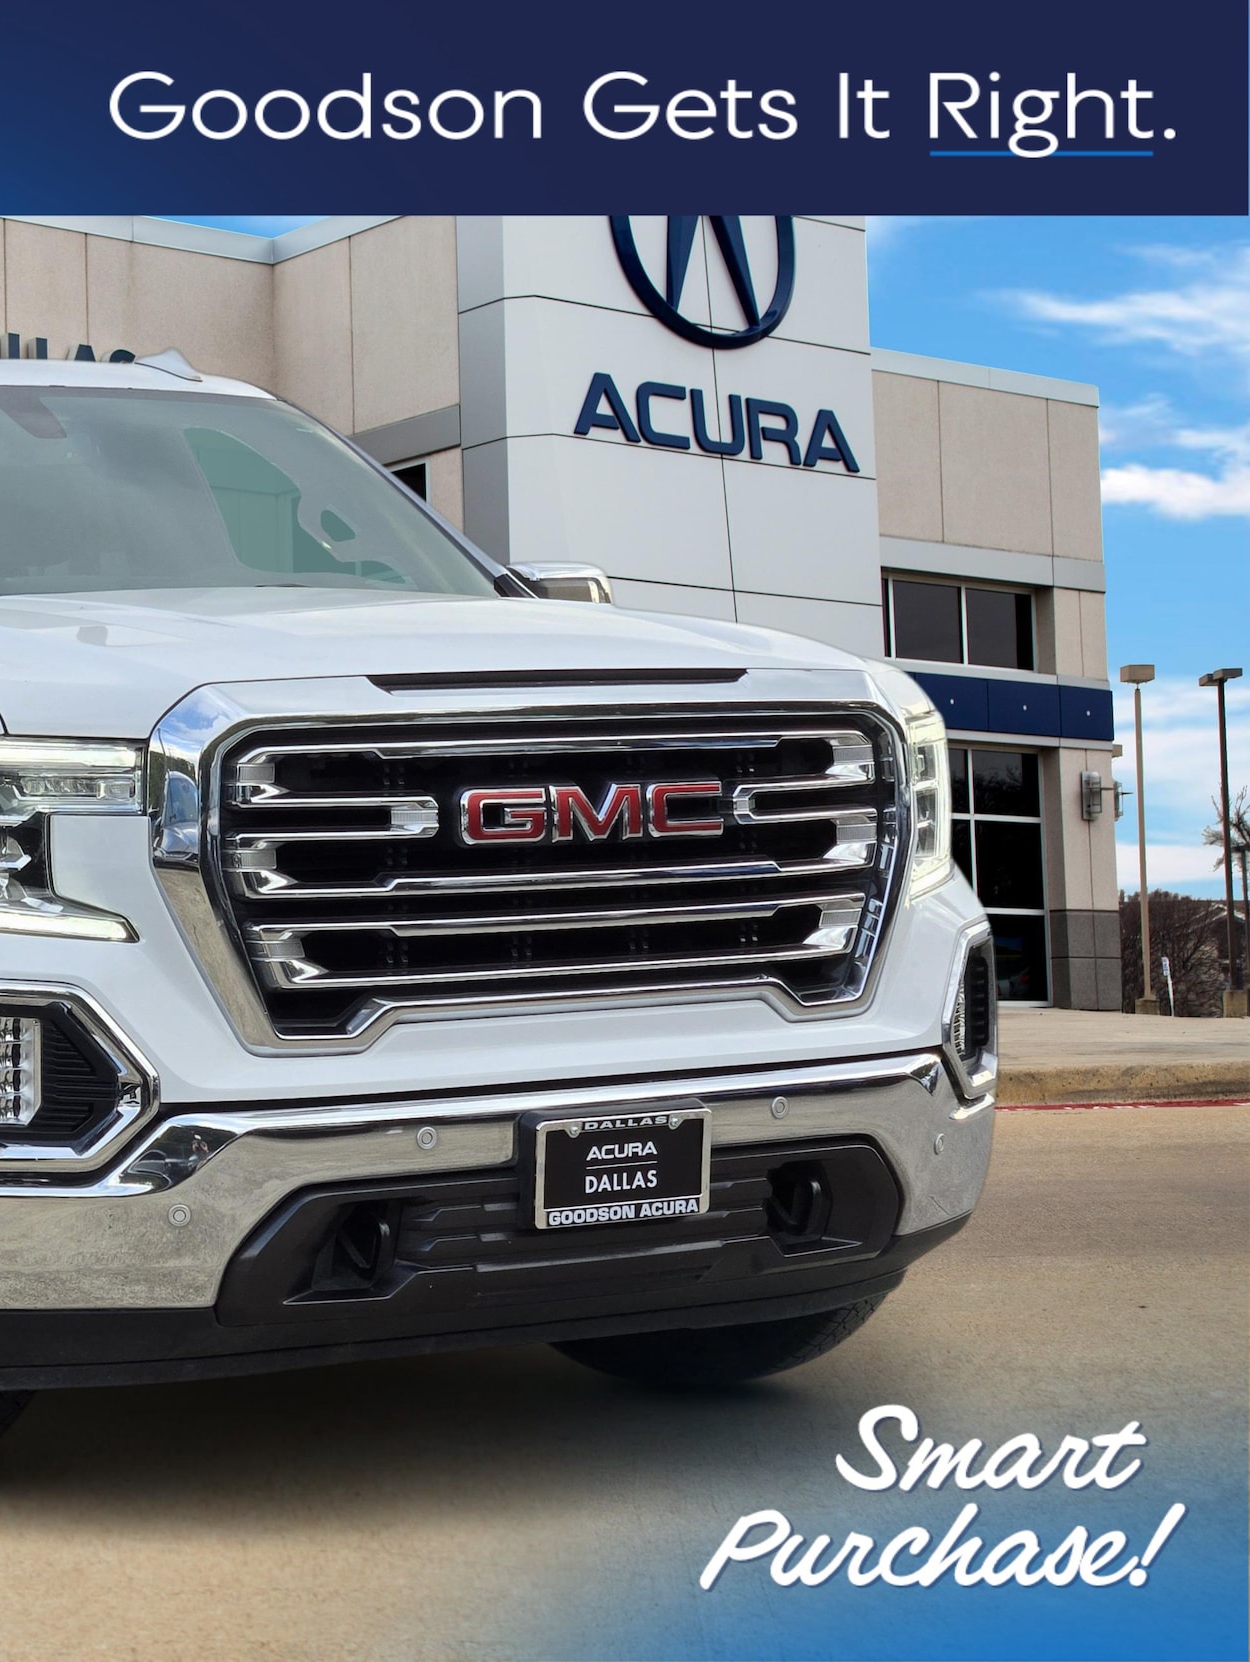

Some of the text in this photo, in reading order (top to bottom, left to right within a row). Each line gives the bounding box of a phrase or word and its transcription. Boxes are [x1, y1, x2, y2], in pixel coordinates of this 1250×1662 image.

[573, 371, 861, 473] ACURA
[460, 780, 724, 845] GMC
[584, 1115, 668, 1131] DALLAS
[585, 1141, 658, 1161] ACURA
[584, 1169, 658, 1194] DALLAS
[548, 1199, 699, 1227] GOODSON ACURA
